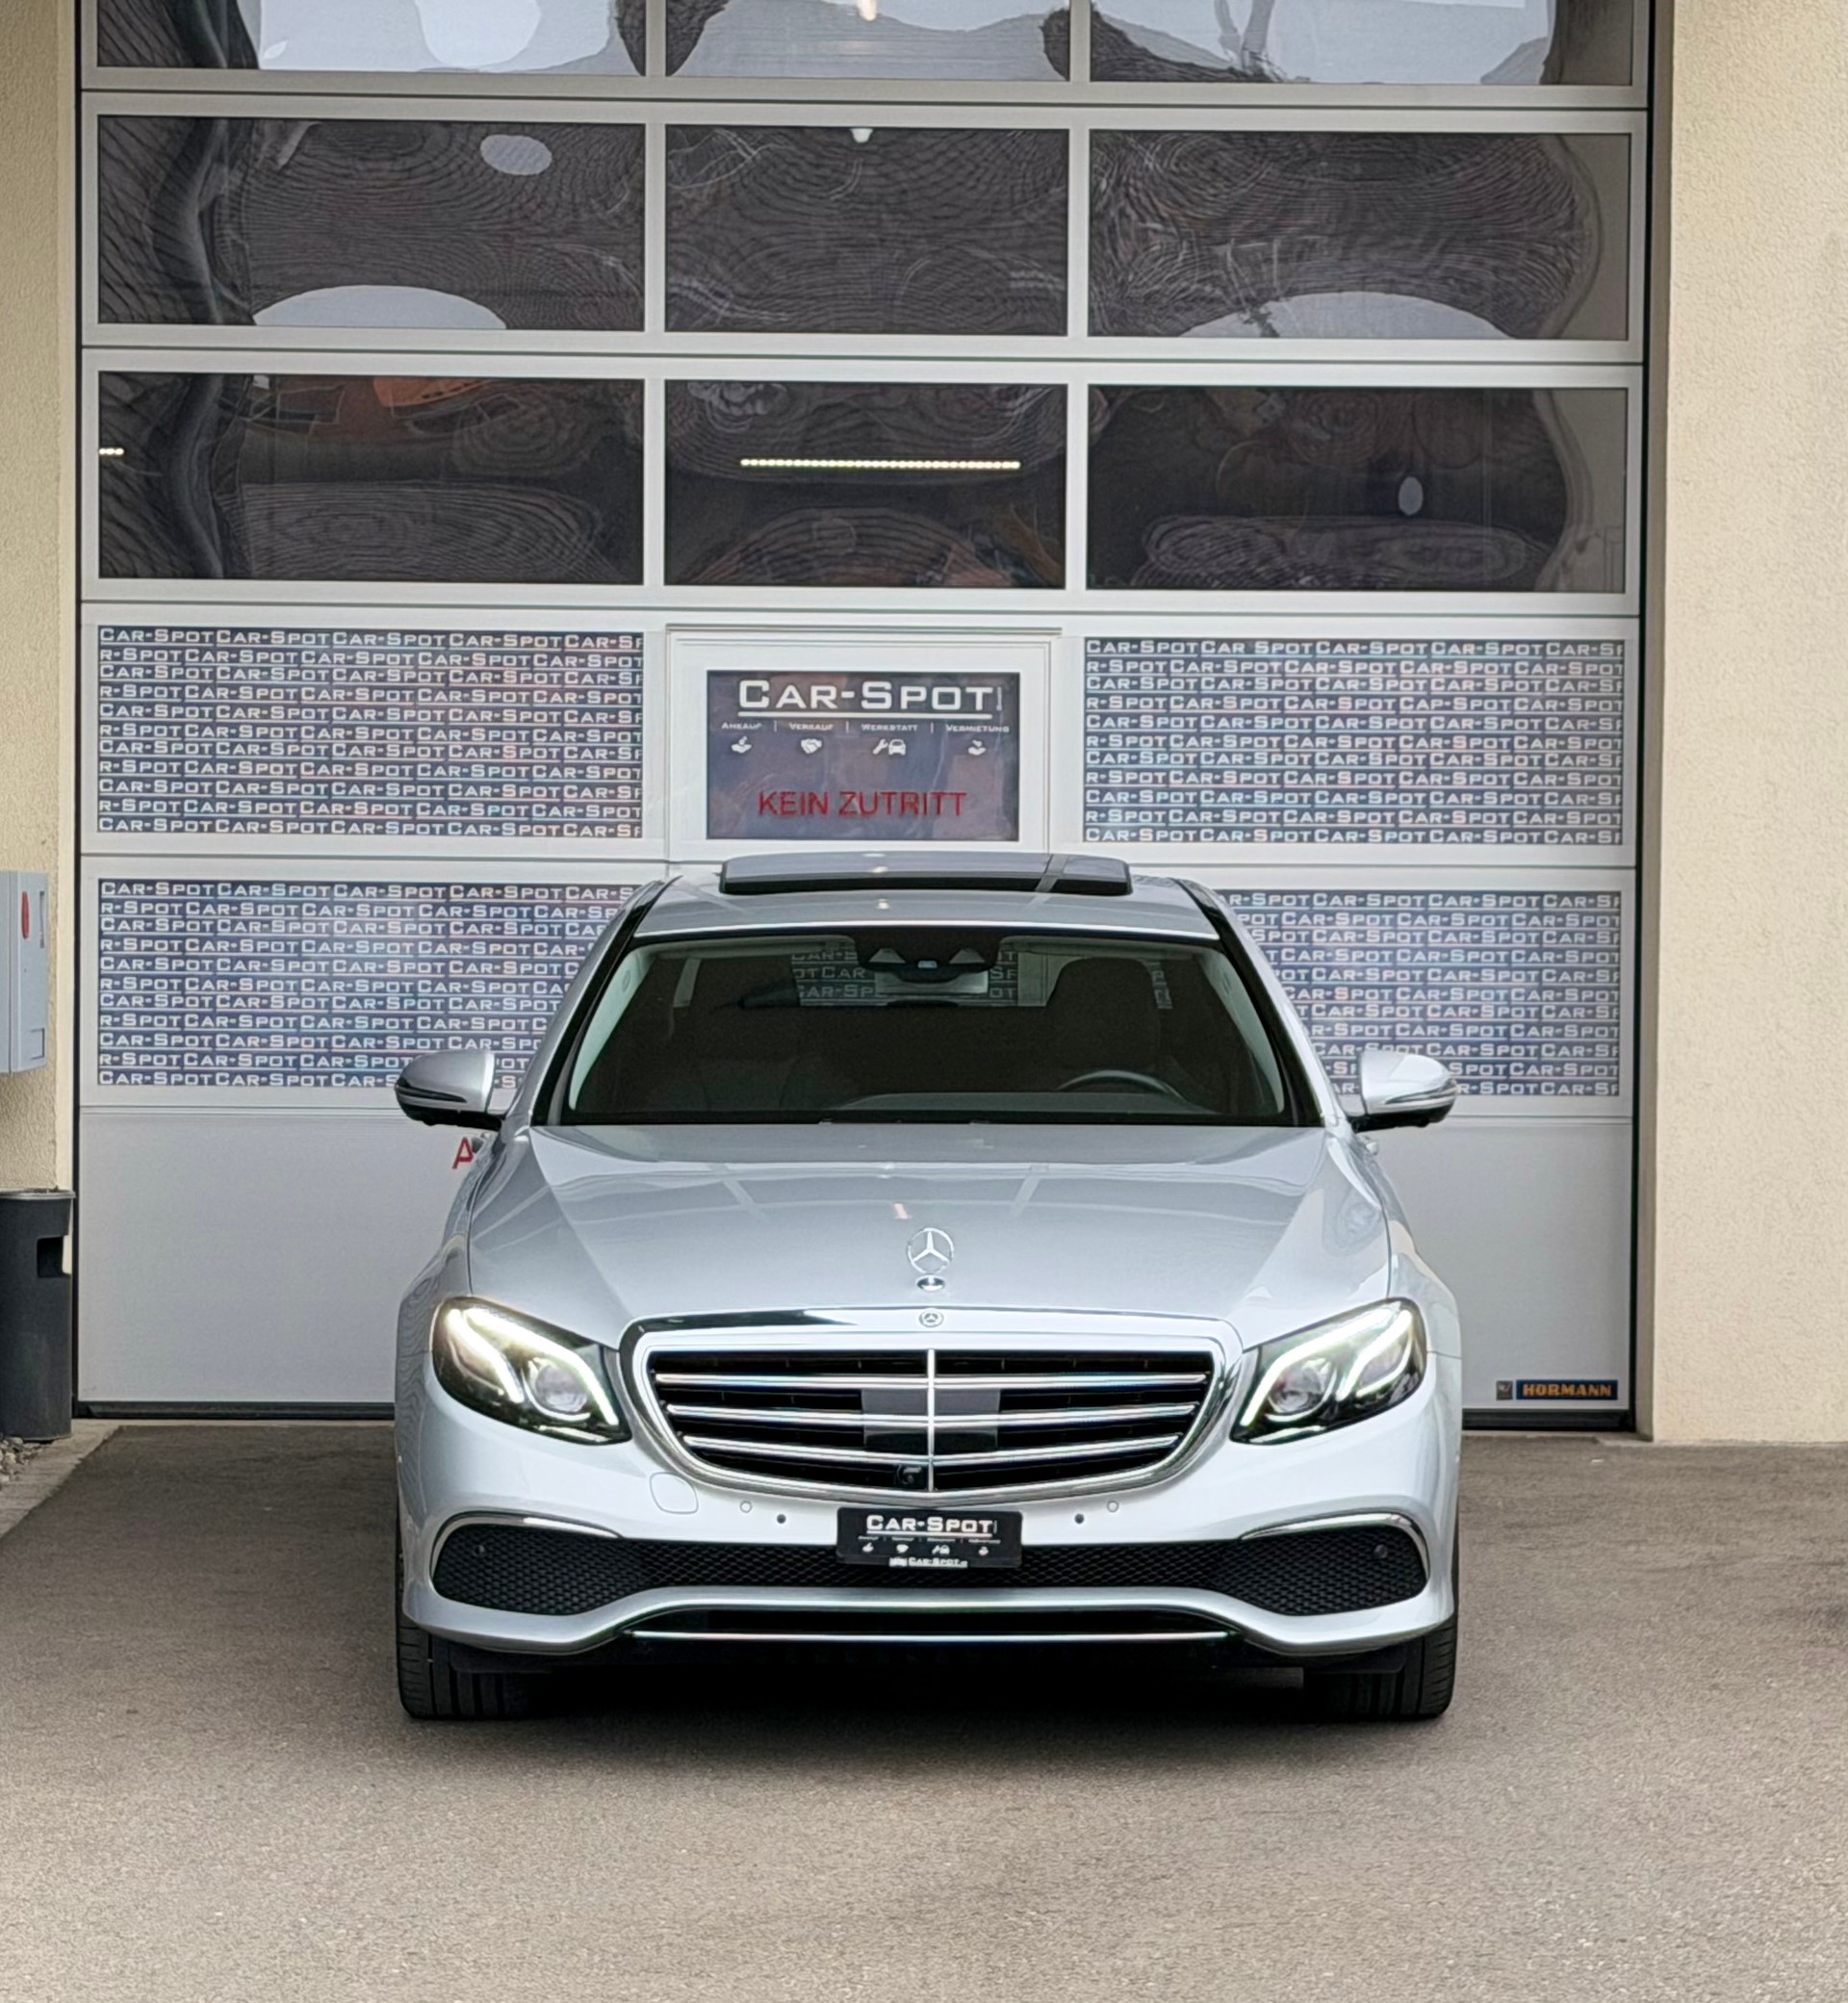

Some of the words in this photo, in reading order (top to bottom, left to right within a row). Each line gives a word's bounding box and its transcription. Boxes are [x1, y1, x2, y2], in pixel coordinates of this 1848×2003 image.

[99, 629, 214, 643] CAR-SPOT
[216, 629, 329, 645] CAR-SPOT
[332, 631, 446, 646] CAR-SPOT
[449, 632, 561, 648] CAR-SPOT
[1086, 640, 1198, 654] CAR-SPOT
[1201, 641, 1313, 654] CARSPOT
[1316, 641, 1427, 655] CAR-SPOT
[1430, 642, 1543, 655] CAR-SPOT
[185, 649, 298, 663] CAR-SPOT
[301, 650, 414, 665] CAR-SPOT
[418, 652, 530, 667] CAR-SPOT
[99, 665, 214, 681] CAR-SPOT
[216, 667, 329, 681] CAR-SPOT
[332, 668, 446, 683] CAR-SPOT
[449, 670, 561, 684] CAR-SPOT
[1169, 659, 1282, 673] CAR-SPOT
[1284, 660, 1397, 674] CAR-SPOT
[1399, 660, 1511, 674] CAR-SPOT
[1086, 677, 1198, 690] CAR-SPOT
[1200, 677, 1313, 690] CAR-SPOT
[1316, 678, 1427, 691] CAR-SPOT
[1430, 678, 1543, 691] CAR-SPOT
[185, 686, 297, 701] CAR-SPOT
[301, 687, 414, 702] CAR-SPOT
[418, 689, 530, 704] CAR-SPOT
[738, 680, 993, 710] CAR-SPOT
[1169, 696, 1282, 709] CAR-SPOT
[1284, 697, 1397, 709] CAR-SPOT
[99, 704, 214, 718] CAR-SPOT
[216, 706, 329, 720] CAR-SPOT
[332, 706, 446, 721] CAR-SPOT
[449, 708, 561, 723] CAR-SPOT
[1086, 715, 1198, 729] CAR-SPOT
[1200, 715, 1312, 729] CAR-SPOT
[1315, 716, 1427, 729] CAR-SPOT
[1430, 716, 1542, 730] CAR-SPOT
[184, 724, 297, 739] CAR-SPOT
[300, 726, 414, 740] CAR-SPOT
[417, 727, 530, 742] CAR-SPOT
[99, 740, 213, 755] CAR-SPOT
[216, 742, 329, 757] CAR-SPOT
[332, 743, 445, 758] CAR-SPOT
[449, 745, 560, 759] CAR-SPOT
[1169, 734, 1281, 748] CAR-SPOT
[1284, 735, 1396, 748] CAR-SPOT
[1399, 735, 1511, 749] CAR-SPOT
[1086, 751, 1198, 764] CAR-SPOT
[1200, 752, 1312, 765] CAR-SPOT
[1315, 752, 1427, 765] CAR-SPOT
[1430, 753, 1542, 766] CAR-SPOT
[184, 761, 297, 776] CAR-SPOT
[300, 762, 414, 777] CAR-SPOT
[417, 764, 529, 779] CAR-SPOT
[1169, 771, 1281, 783] CAR-SPOT
[1284, 771, 1396, 784] CAR-SPOT
[1399, 772, 1511, 784] CAR-SPOT
[98, 780, 213, 794] CAR-SPOT
[216, 781, 329, 795] CAR-SPOT
[331, 783, 445, 797] CAR-SPOT
[449, 783, 560, 798] CAR-SPOT
[1086, 789, 1198, 803] CAR-SPOT
[1200, 790, 1312, 804] CAR-SPOT
[1315, 790, 1427, 804] CAR-SPOT
[1430, 791, 1542, 805] CAR-SPOT
[184, 800, 297, 814] CAR-SPOT
[300, 801, 413, 815] CAR-SPOT
[417, 802, 529, 817] CAR-SPOT
[757, 791, 830, 816] KEIN
[838, 791, 967, 817] ZUTRITT
[1169, 809, 1281, 822] CAR-SPOT
[1284, 809, 1396, 823] CAR-SPOT
[1399, 810, 1510, 824] CAR-SPOT
[98, 818, 213, 833] CAR-SPOT
[215, 819, 328, 834] CAR-SPOT
[331, 820, 445, 835] CAR-SPOT
[448, 821, 560, 835] CAR-SPOT
[1086, 828, 1197, 841] CAR-SPOT
[1200, 829, 1312, 841] CAR-SPOT
[1315, 829, 1426, 842] CAR-SPOT
[1430, 830, 1542, 842] CAR-SPOT
[101, 882, 215, 896] CAR-SPOT
[218, 884, 331, 898] CAR-SPOT
[334, 885, 447, 899] CAR-SPOT
[449, 886, 563, 900] CAR-SPOT
[1313, 893, 1425, 907] CAR-SPOT
[1428, 894, 1540, 908] CAR-SPOT
[186, 902, 299, 916] CAR-SPOT
[302, 903, 415, 917] CAR-SPOT
[418, 904, 531, 918] CAR-SPOT
[100, 917, 215, 932] CAR-SPOT
[217, 919, 330, 934] CAR-SPOT
[333, 920, 446, 935] CAR-SPOT
[449, 921, 562, 937] CAR-SPOT
[1281, 912, 1394, 926] CAR-SPOT
[1397, 913, 1509, 927] CAR-SPOT
[1313, 930, 1425, 943] CAR-SPOT
[1427, 930, 1540, 943] CAR-SPOT
[186, 938, 299, 954] CAR-SPOT
[301, 940, 414, 955] CAR-SPOT
[418, 941, 530, 957] CAR-SPOT
[1281, 949, 1393, 963] CAR-SPOT
[1397, 950, 1508, 963] CAR-SPOT
[100, 957, 214, 972] CAR-SPOT
[217, 959, 330, 973] CAR-SPOT
[333, 960, 446, 974] CAR-SPOT
[449, 961, 562, 975] CAR-SPOT
[1313, 968, 1424, 982] CAR-SPOT
[1427, 968, 1540, 982] CAR-SPOT
[185, 978, 298, 992] CAR-SPOT
[301, 979, 414, 993] CAR-SPOT
[418, 980, 530, 994] CAR-SPOT
[100, 993, 214, 1009] CAR-SPOT
[216, 995, 329, 1010] CAR-SPOT
[333, 996, 445, 1011] CAR-SPOT
[449, 997, 560, 1012] CAR-SPOT
[1396, 989, 1508, 1002] CAR-SPOT
[1312, 1004, 1424, 1017] CAR-SPOT
[1427, 1005, 1539, 1018] CAR-SPOT
[185, 1014, 298, 1029] CAR-SPOT
[301, 1015, 413, 1030] CAR-SPOT
[417, 1016, 530, 1031] CAR-SPOT
[1396, 1023, 1508, 1037] CAR-SPOT
[99, 1033, 214, 1047] CAR-SPOT
[216, 1034, 329, 1048] CAR-SPOT
[332, 1035, 445, 1049] CAR-SPOT
[1426, 1043, 1539, 1057] CAR-SPOT
[185, 1054, 297, 1068] CAR-SPOT
[99, 1071, 213, 1086] CAR-SPOT
[216, 1072, 329, 1087] CAR-SPOT
[866, 1514, 993, 1533] CAR-SPOT
